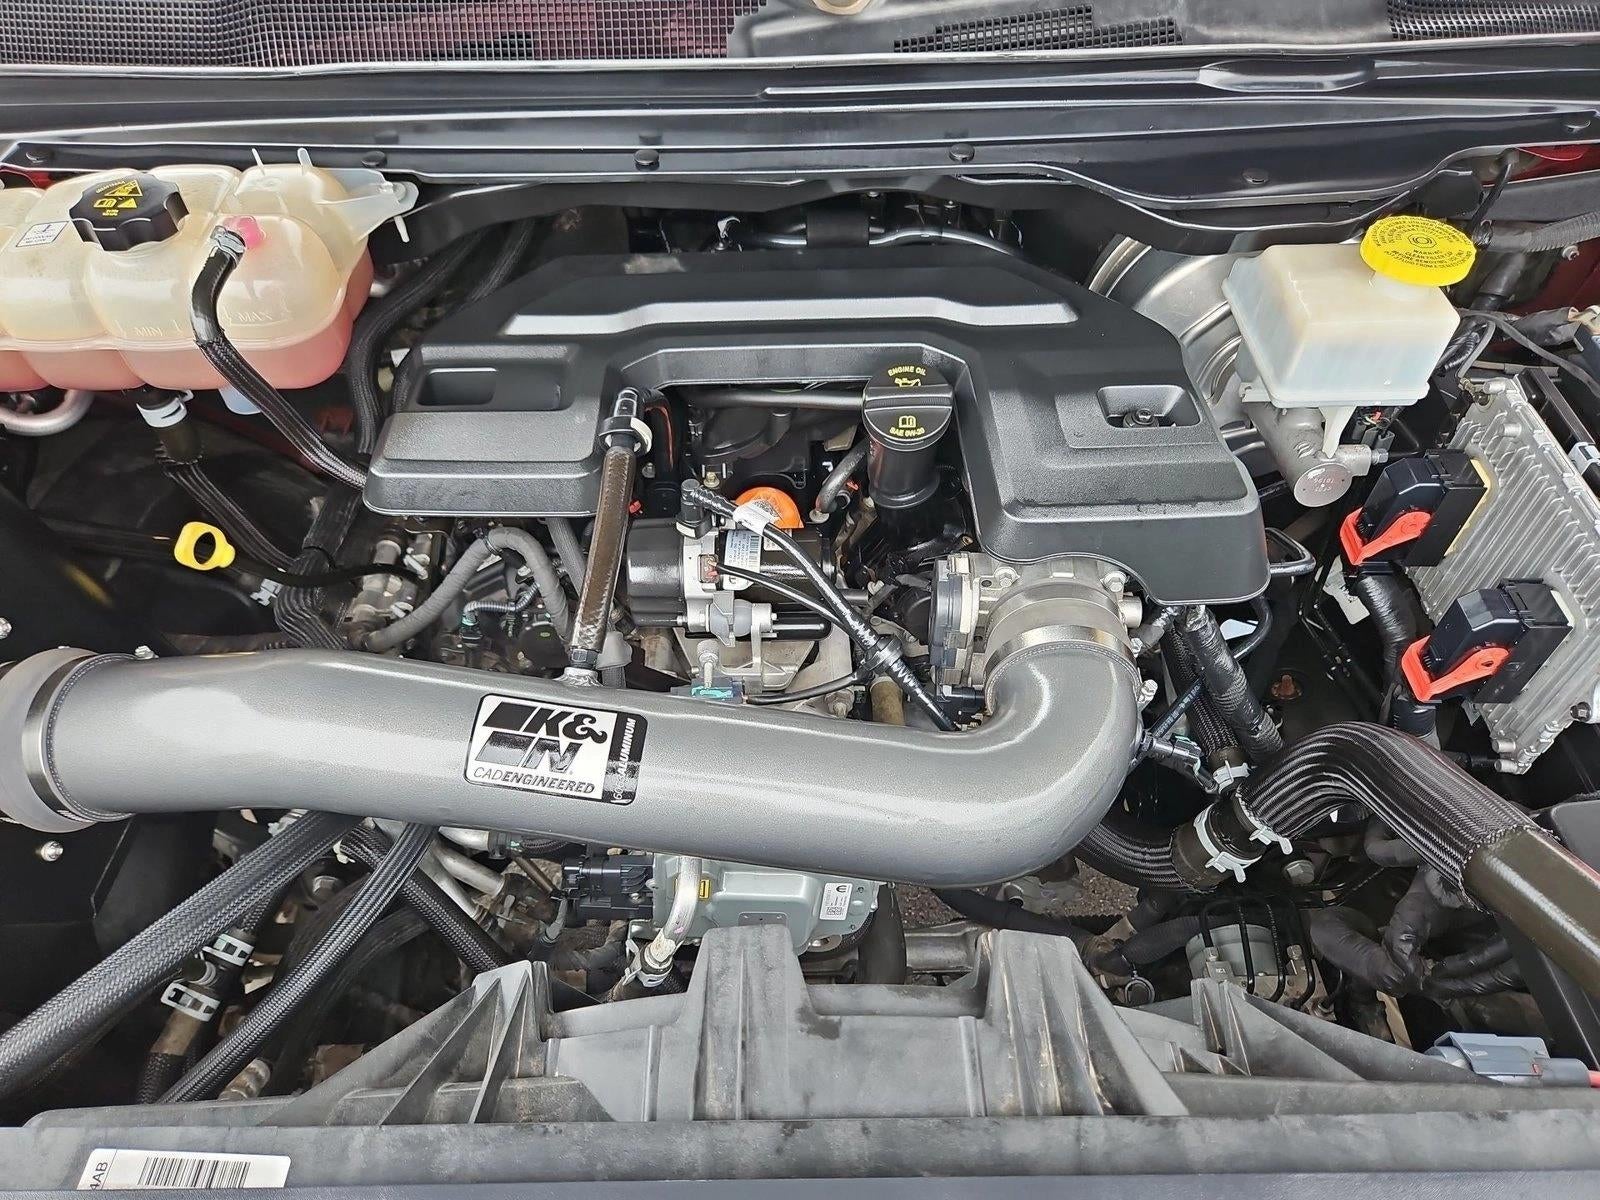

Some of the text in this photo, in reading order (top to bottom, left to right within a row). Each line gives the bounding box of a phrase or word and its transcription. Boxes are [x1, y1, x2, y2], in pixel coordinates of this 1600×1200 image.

[887, 365, 926, 377] ENGINE OIL
[889, 426, 904, 437] SAE
[89, 1161, 109, 1191] 4AB
